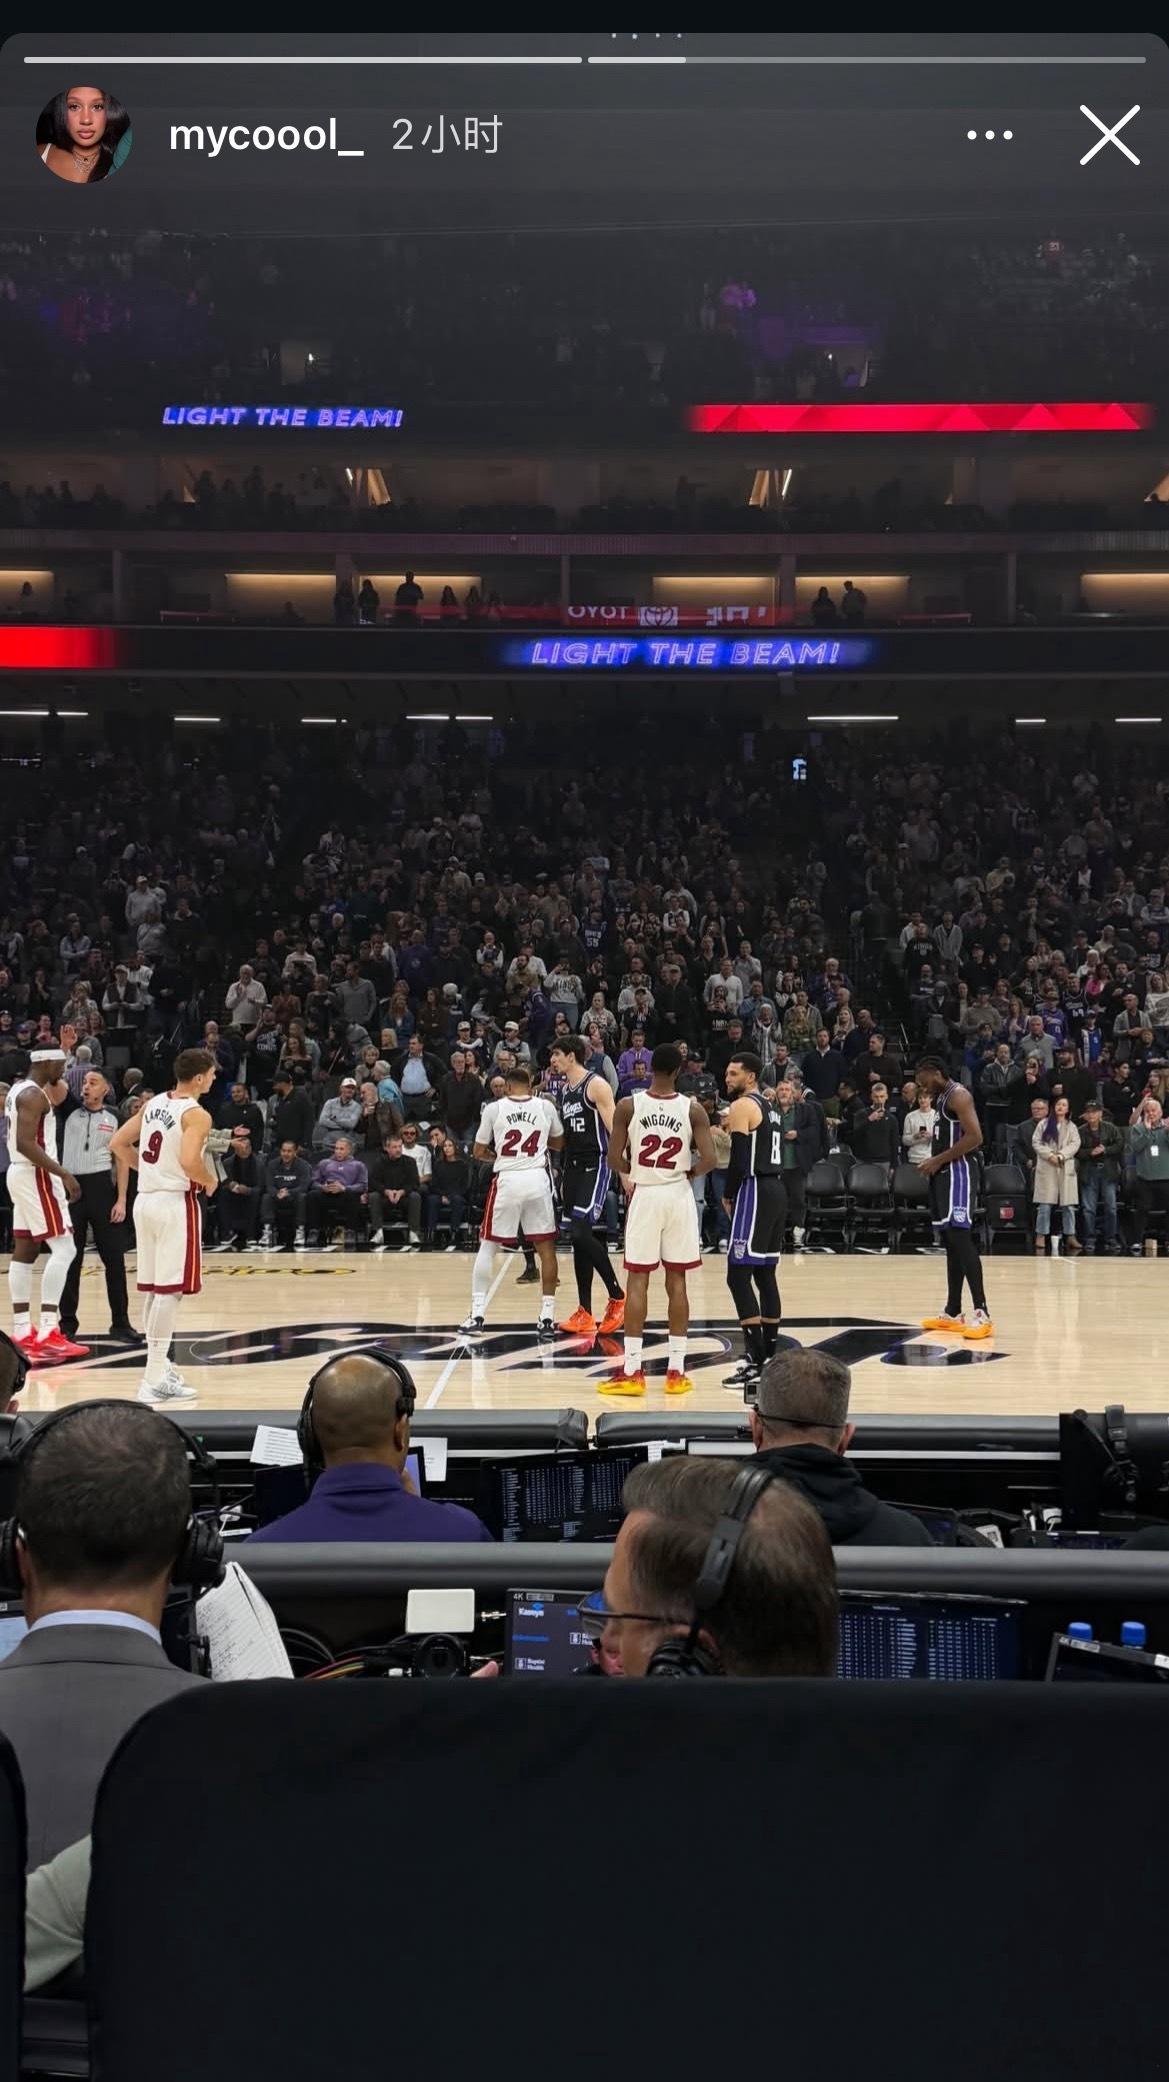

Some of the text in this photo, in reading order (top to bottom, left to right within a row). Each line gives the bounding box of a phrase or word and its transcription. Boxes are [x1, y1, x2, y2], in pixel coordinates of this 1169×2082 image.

[162, 406, 404, 428] LIGHT THE BEAM!
[531, 642, 840, 665] LIGHT THE BEAM!
[145, 1108, 176, 1130] LARSSON
[506, 1111, 538, 1126] POWELL
[570, 1117, 586, 1133] 42
[639, 1114, 683, 1134] WIGGINS
[142, 1130, 163, 1165] 9
[501, 1129, 542, 1157] 24
[638, 1134, 683, 1169] 22
[770, 1130, 782, 1165] 8
[513, 1592, 524, 1601] 4K
